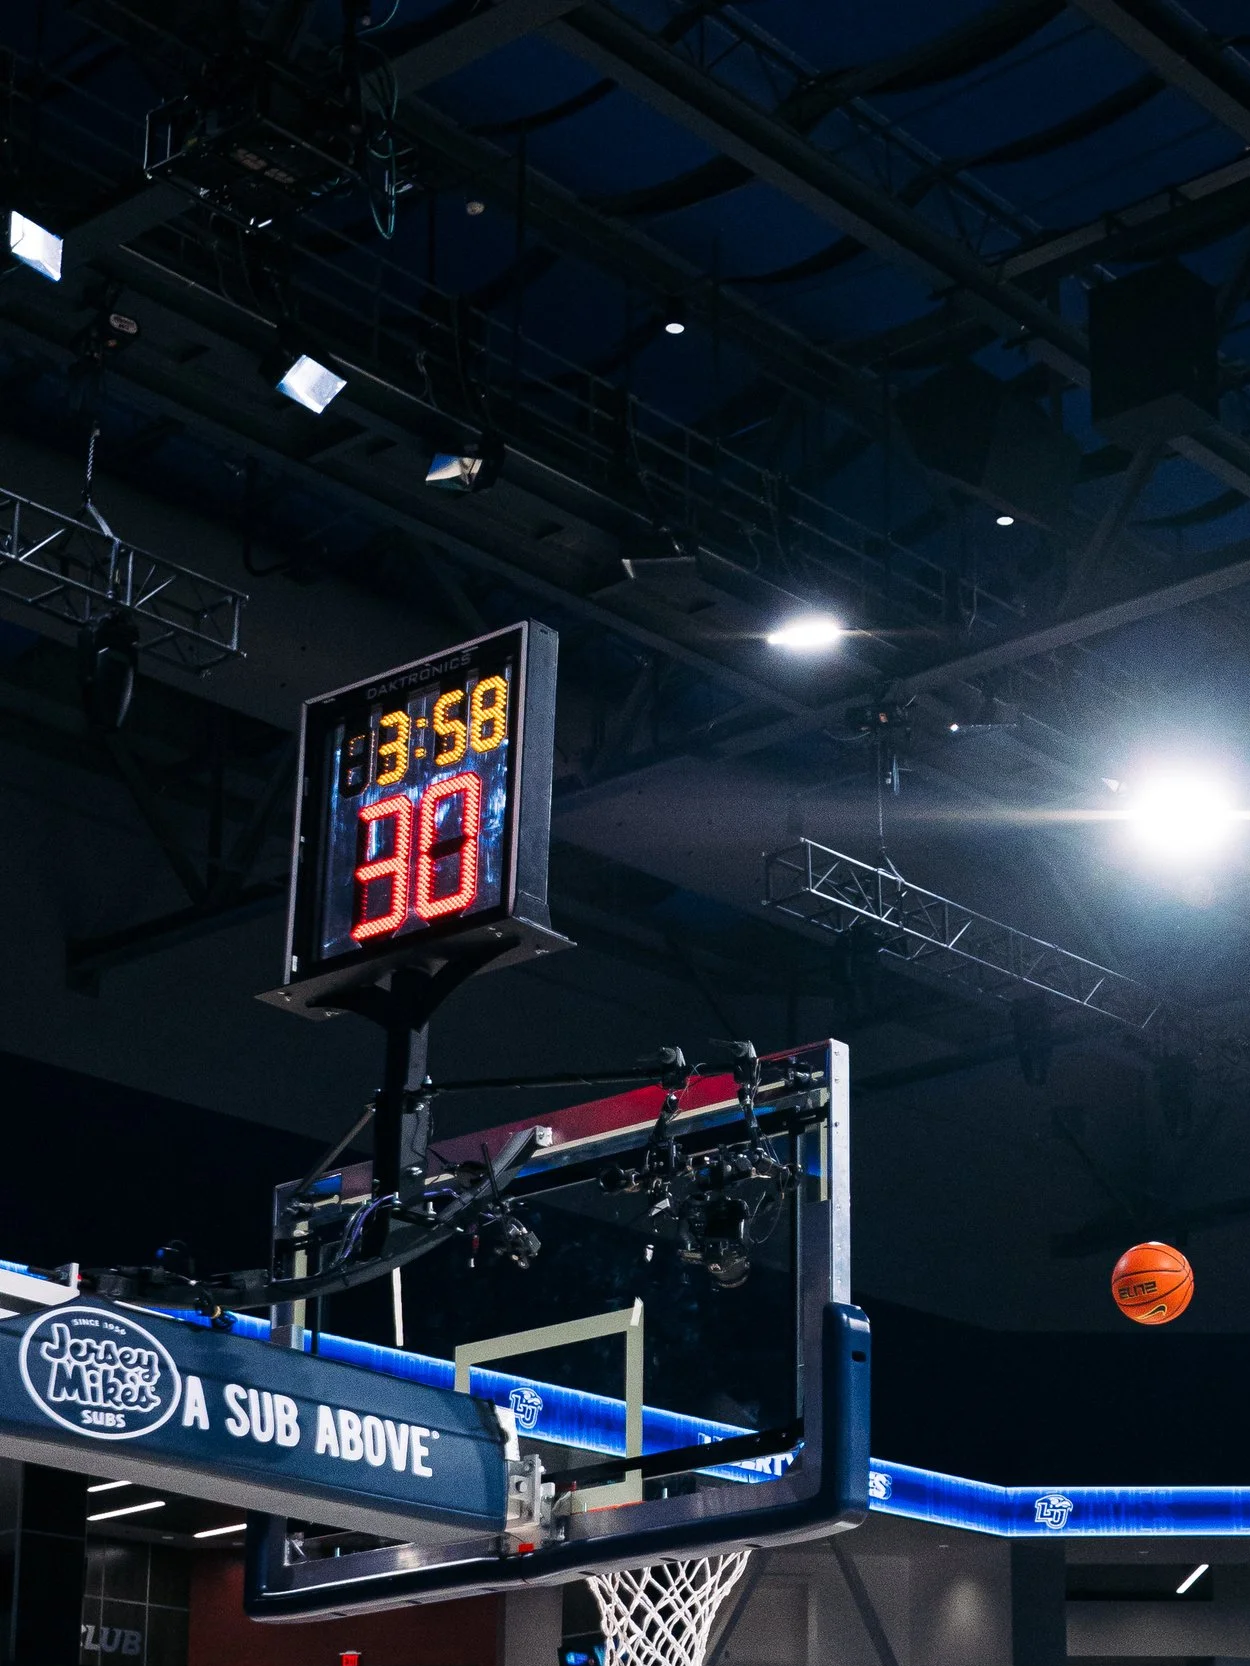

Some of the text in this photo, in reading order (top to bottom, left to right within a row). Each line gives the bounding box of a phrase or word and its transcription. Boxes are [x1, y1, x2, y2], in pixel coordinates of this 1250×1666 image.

[366, 651, 472, 700] DAKTRONICS
[376, 675, 508, 787] 3:58
[351, 771, 482, 941] 30
[1118, 1280, 1158, 1299] ELITE
[40, 1323, 161, 1385] Jersey
[72, 1318, 127, 1336] SINCE 1956
[81, 1410, 126, 1428] SUBS
[182, 1375, 210, 1430] A
[223, 1383, 301, 1448] SUB
